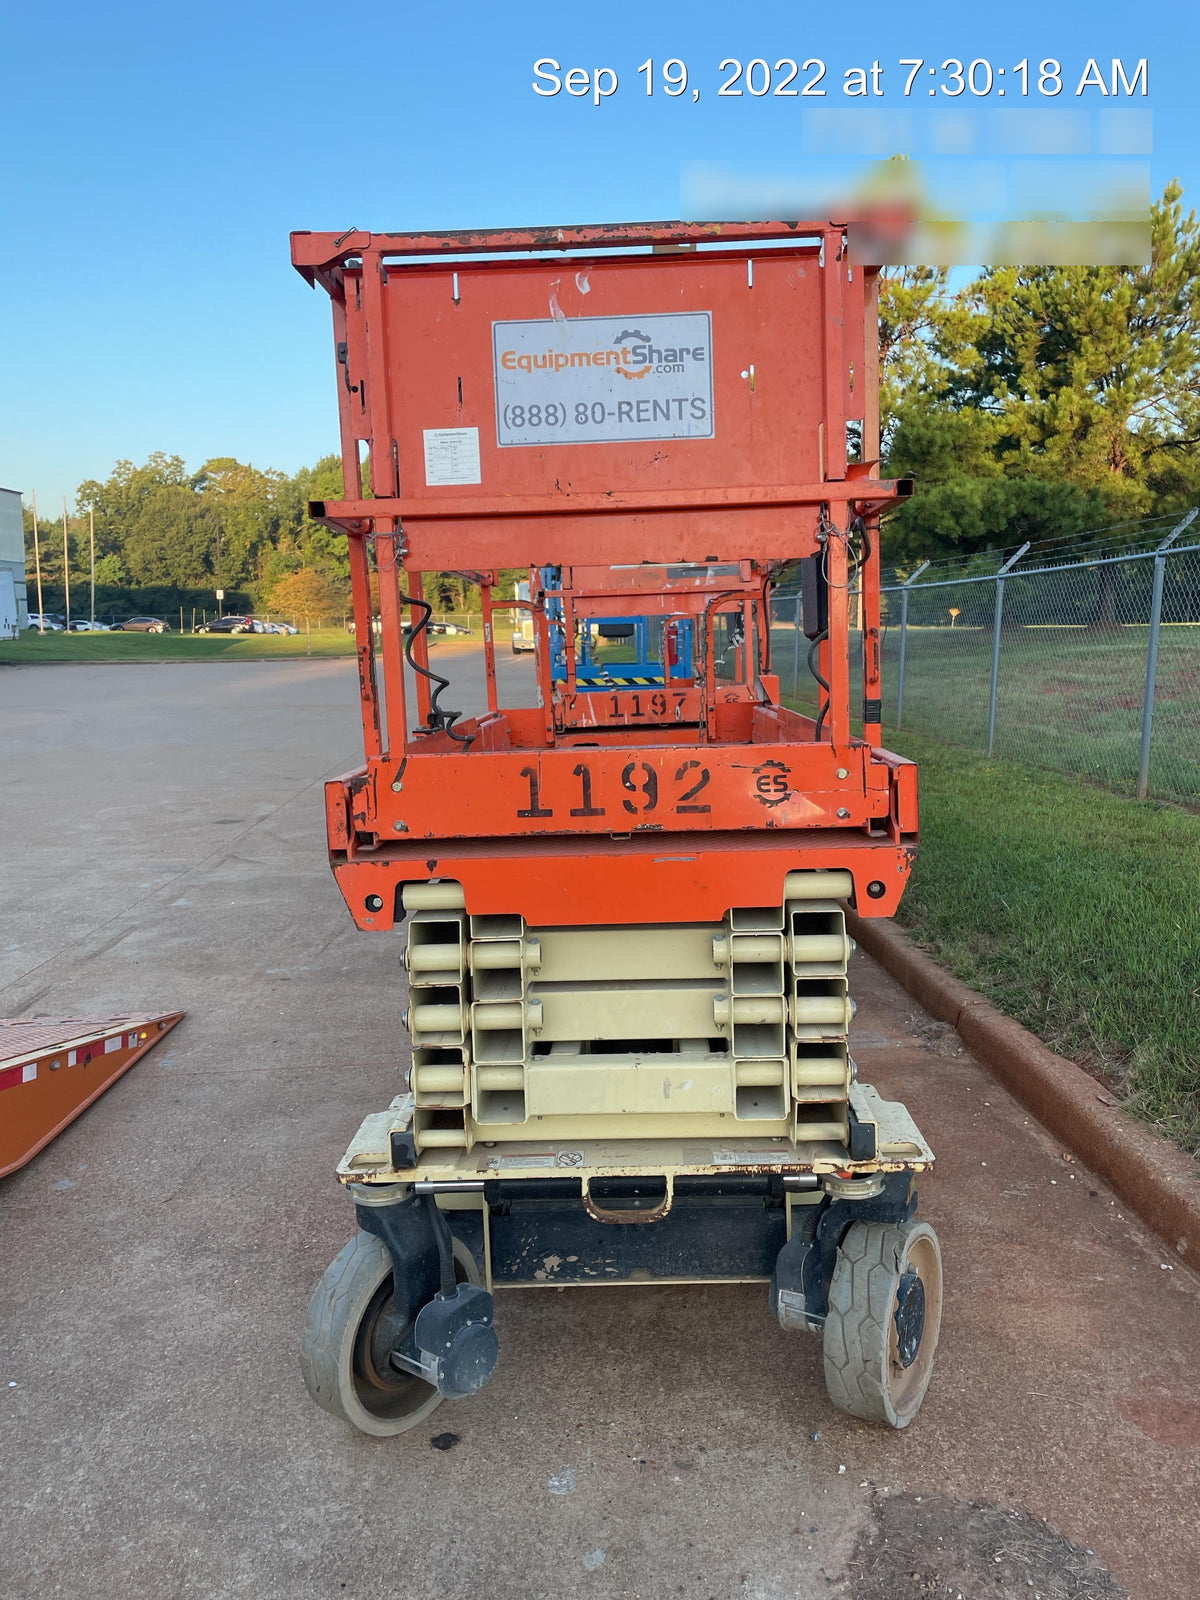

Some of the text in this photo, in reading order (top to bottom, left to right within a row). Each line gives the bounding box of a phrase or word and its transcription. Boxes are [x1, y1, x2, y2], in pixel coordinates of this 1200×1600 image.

[501, 344, 705, 374] EquipmentShare
[652, 363, 685, 375] .com
[503, 397, 706, 430] (888) 80-RENTS
[608, 692, 688, 718] 1197
[516, 759, 711, 818] 1192
[756, 774, 788, 793] ES
